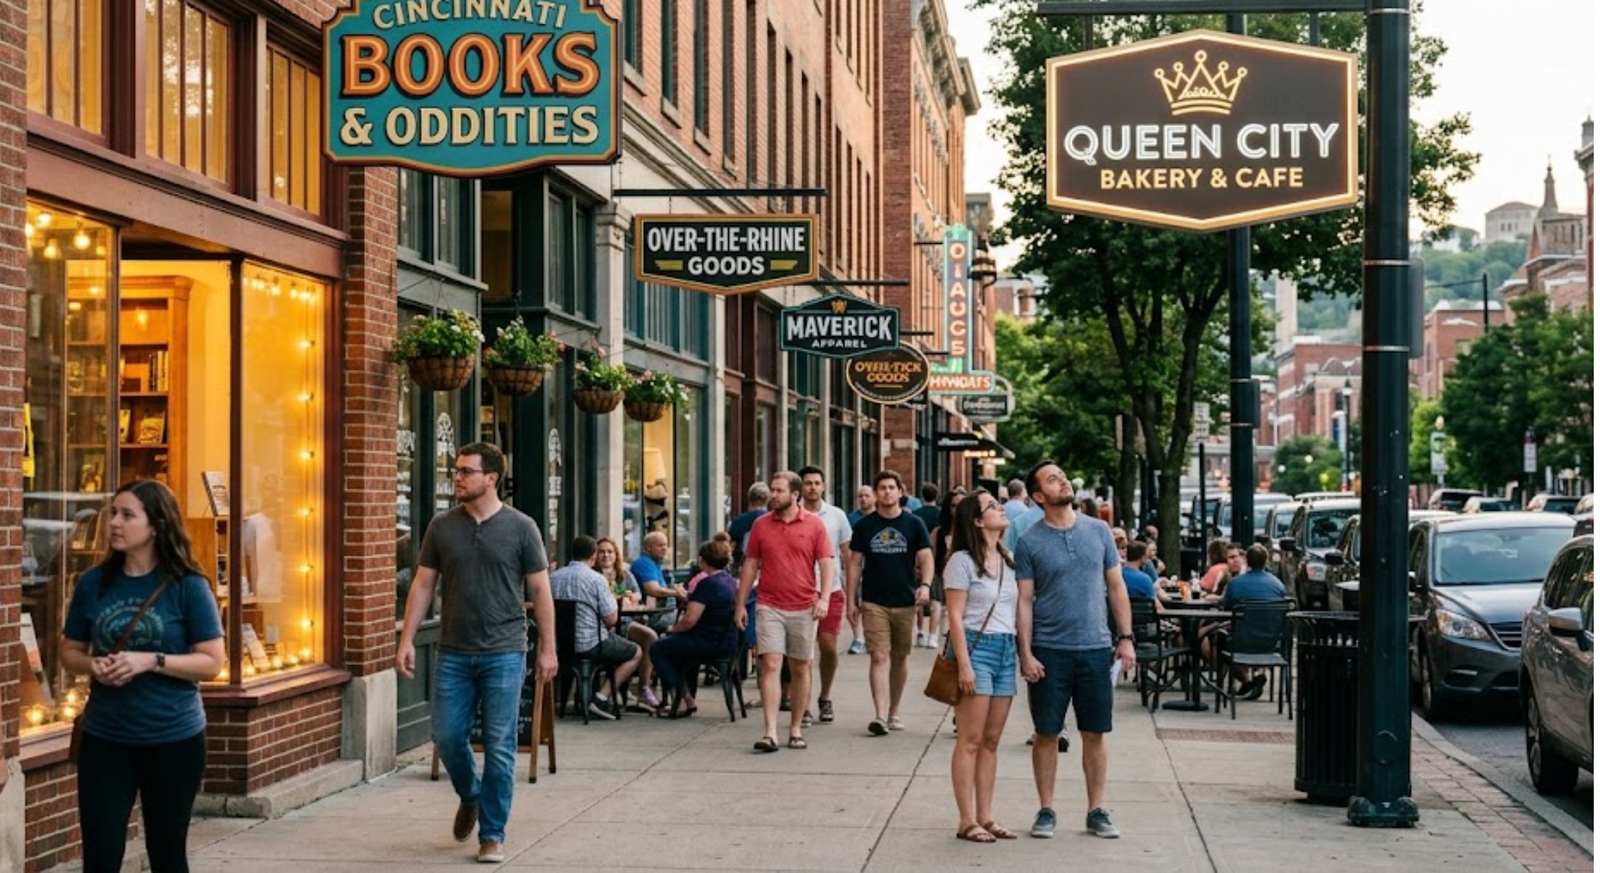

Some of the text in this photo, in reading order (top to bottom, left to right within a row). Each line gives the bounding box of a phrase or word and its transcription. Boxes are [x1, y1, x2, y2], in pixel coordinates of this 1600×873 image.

[373, 0, 566, 29] CINCINNATI
[341, 32, 600, 97] BOOKS
[340, 105, 599, 146] & ODDITIES
[1064, 123, 1340, 166] QUEEN CITY
[1100, 167, 1304, 190] BAKERY & CAFE
[647, 226, 806, 252] OVER-THE-RHINE
[687, 256, 765, 275] GOODS
[786, 315, 893, 342] MAVERICK
[811, 339, 868, 349] APPAREL
